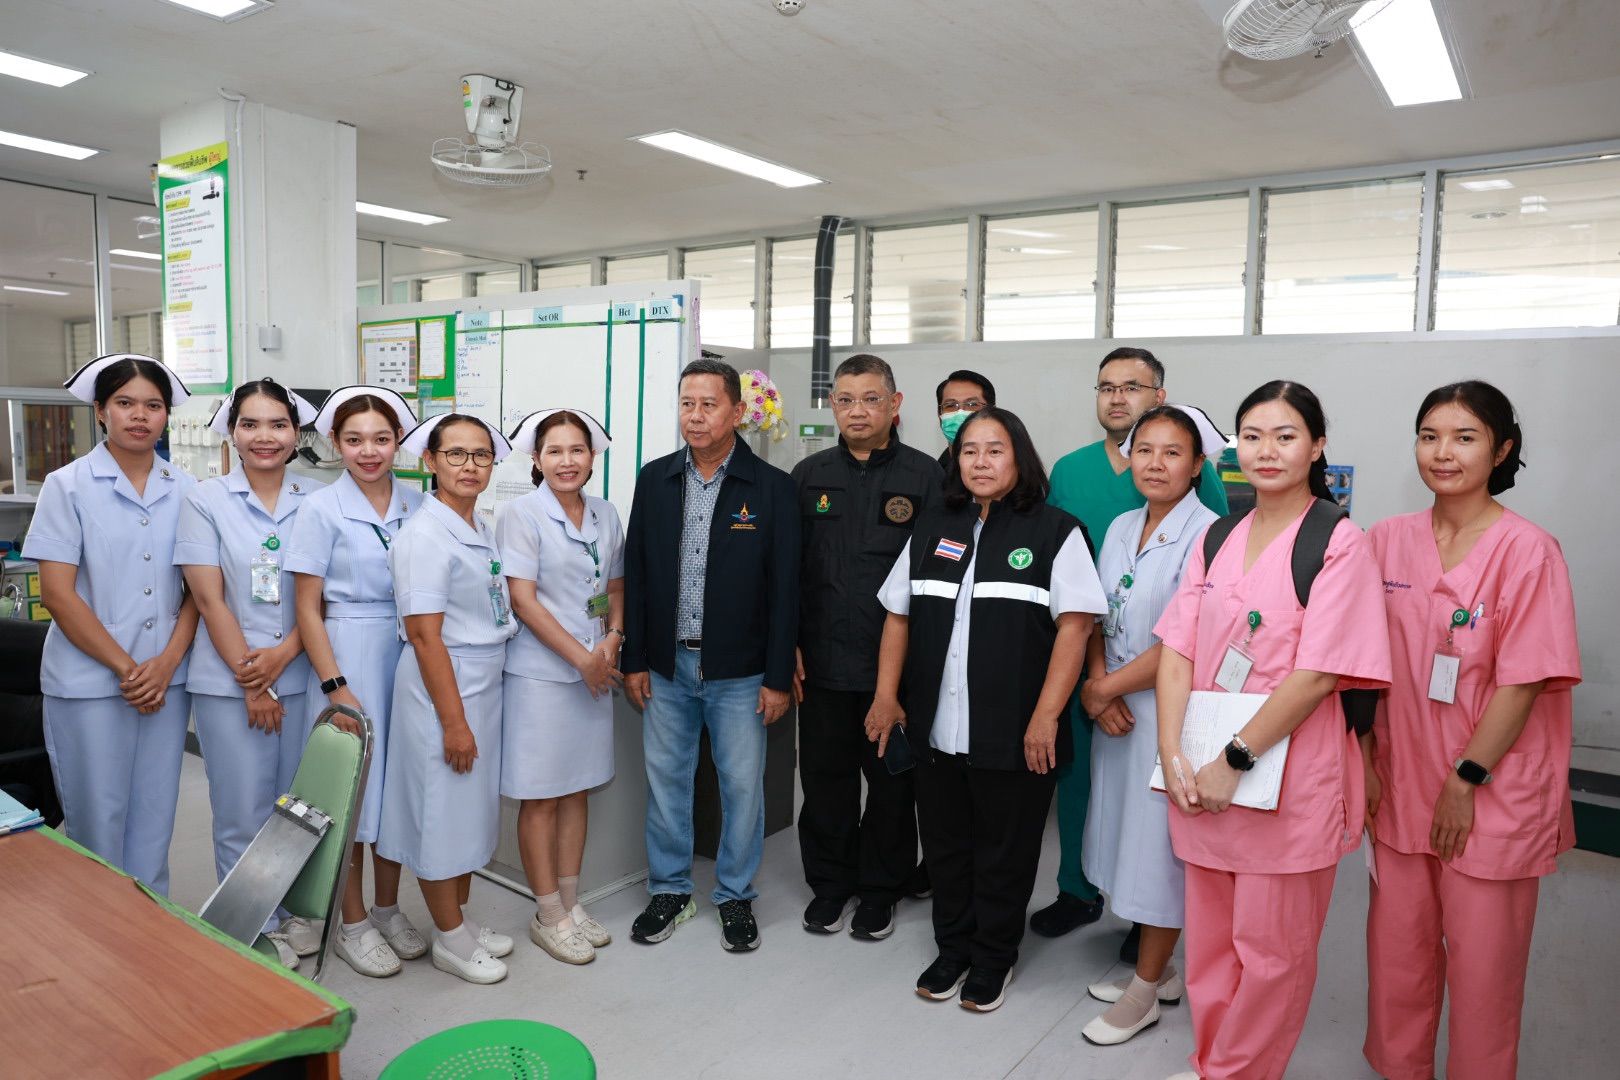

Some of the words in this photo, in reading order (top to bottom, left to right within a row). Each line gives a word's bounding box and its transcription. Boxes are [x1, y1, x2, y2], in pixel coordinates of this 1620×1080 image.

[618, 308, 631, 317] Hct
[652, 306, 669, 316] DTX
[548, 313, 559, 321] OR
